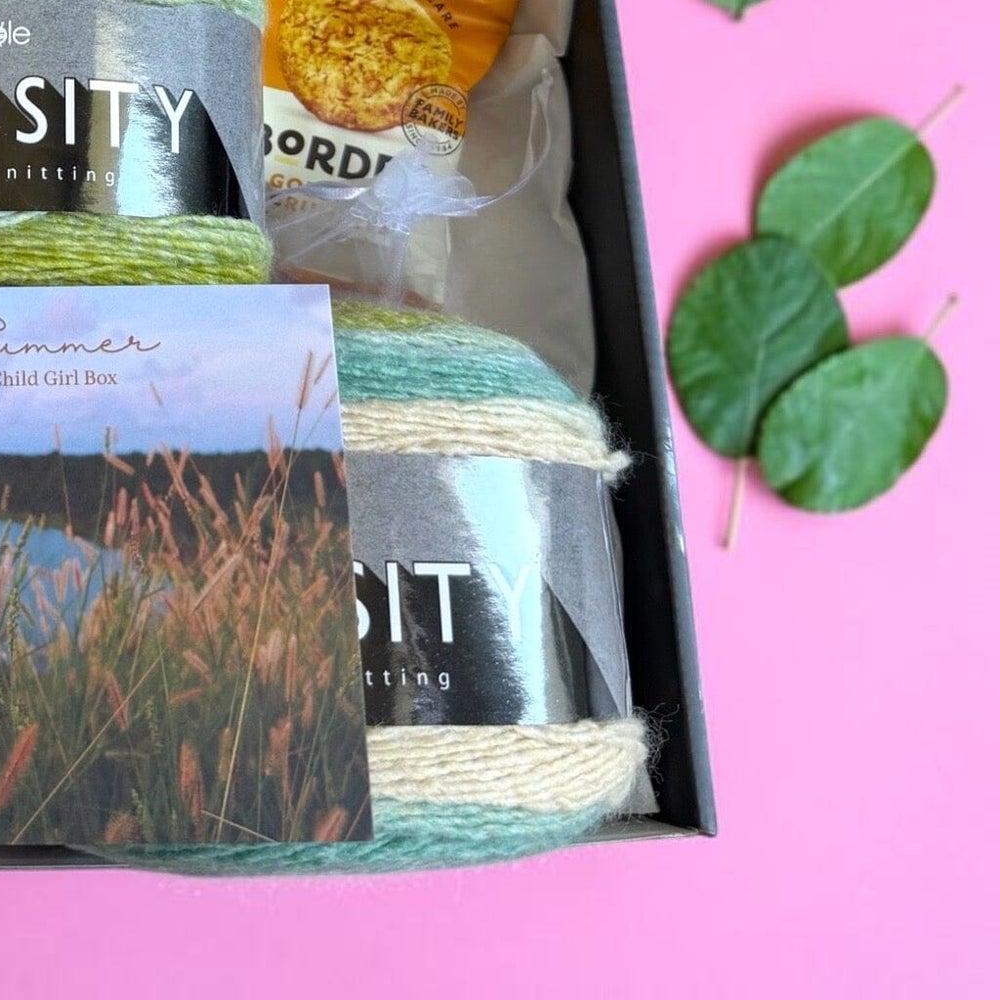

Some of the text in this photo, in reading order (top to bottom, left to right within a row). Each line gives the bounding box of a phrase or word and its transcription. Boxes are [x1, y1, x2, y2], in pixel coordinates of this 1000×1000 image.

[430, 87, 458, 101] MADE
[408, 108, 460, 141] BAKERS
[414, 98, 464, 129] FAMILY
[43, 369, 79, 387] Girl
[83, 369, 119, 386] Box
[364, 667, 450, 691] tting
